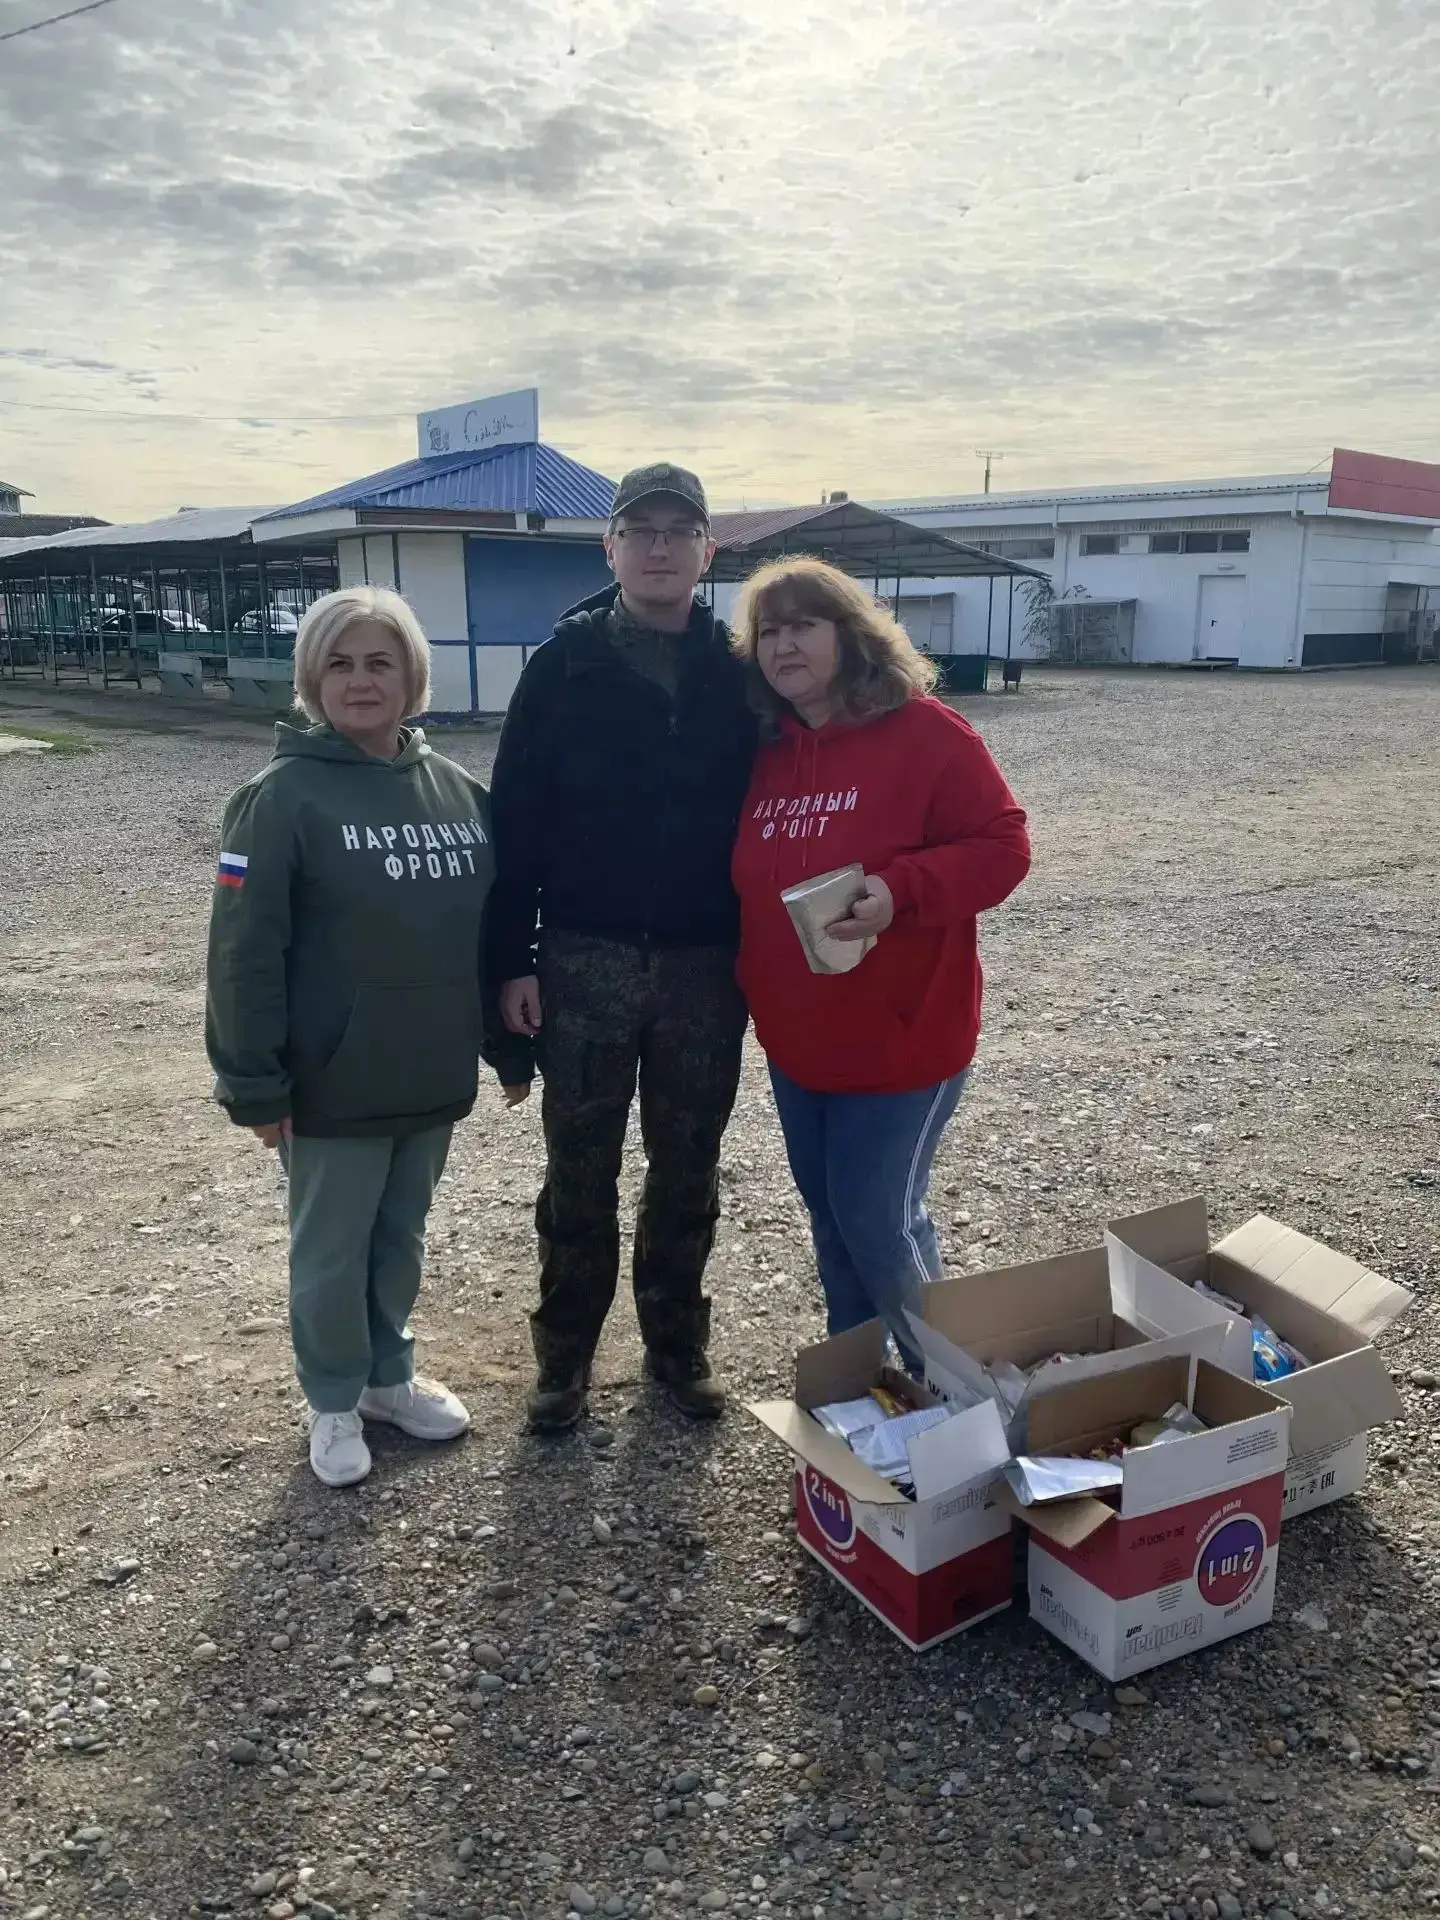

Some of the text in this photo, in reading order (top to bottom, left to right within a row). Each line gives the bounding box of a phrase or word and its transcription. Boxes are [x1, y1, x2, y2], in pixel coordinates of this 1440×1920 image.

[752, 786, 859, 819] НАРОДНЫЙ
[341, 818, 489, 850] НАРОДНЫЙ
[384, 849, 476, 880] ФРОНТ
[809, 1472, 845, 1522] 2 in 1
[1207, 1559, 1217, 1586] 1
[1221, 1554, 1239, 1577] in
[1243, 1544, 1256, 1572] 2
[1125, 1623, 1143, 1638] soft
